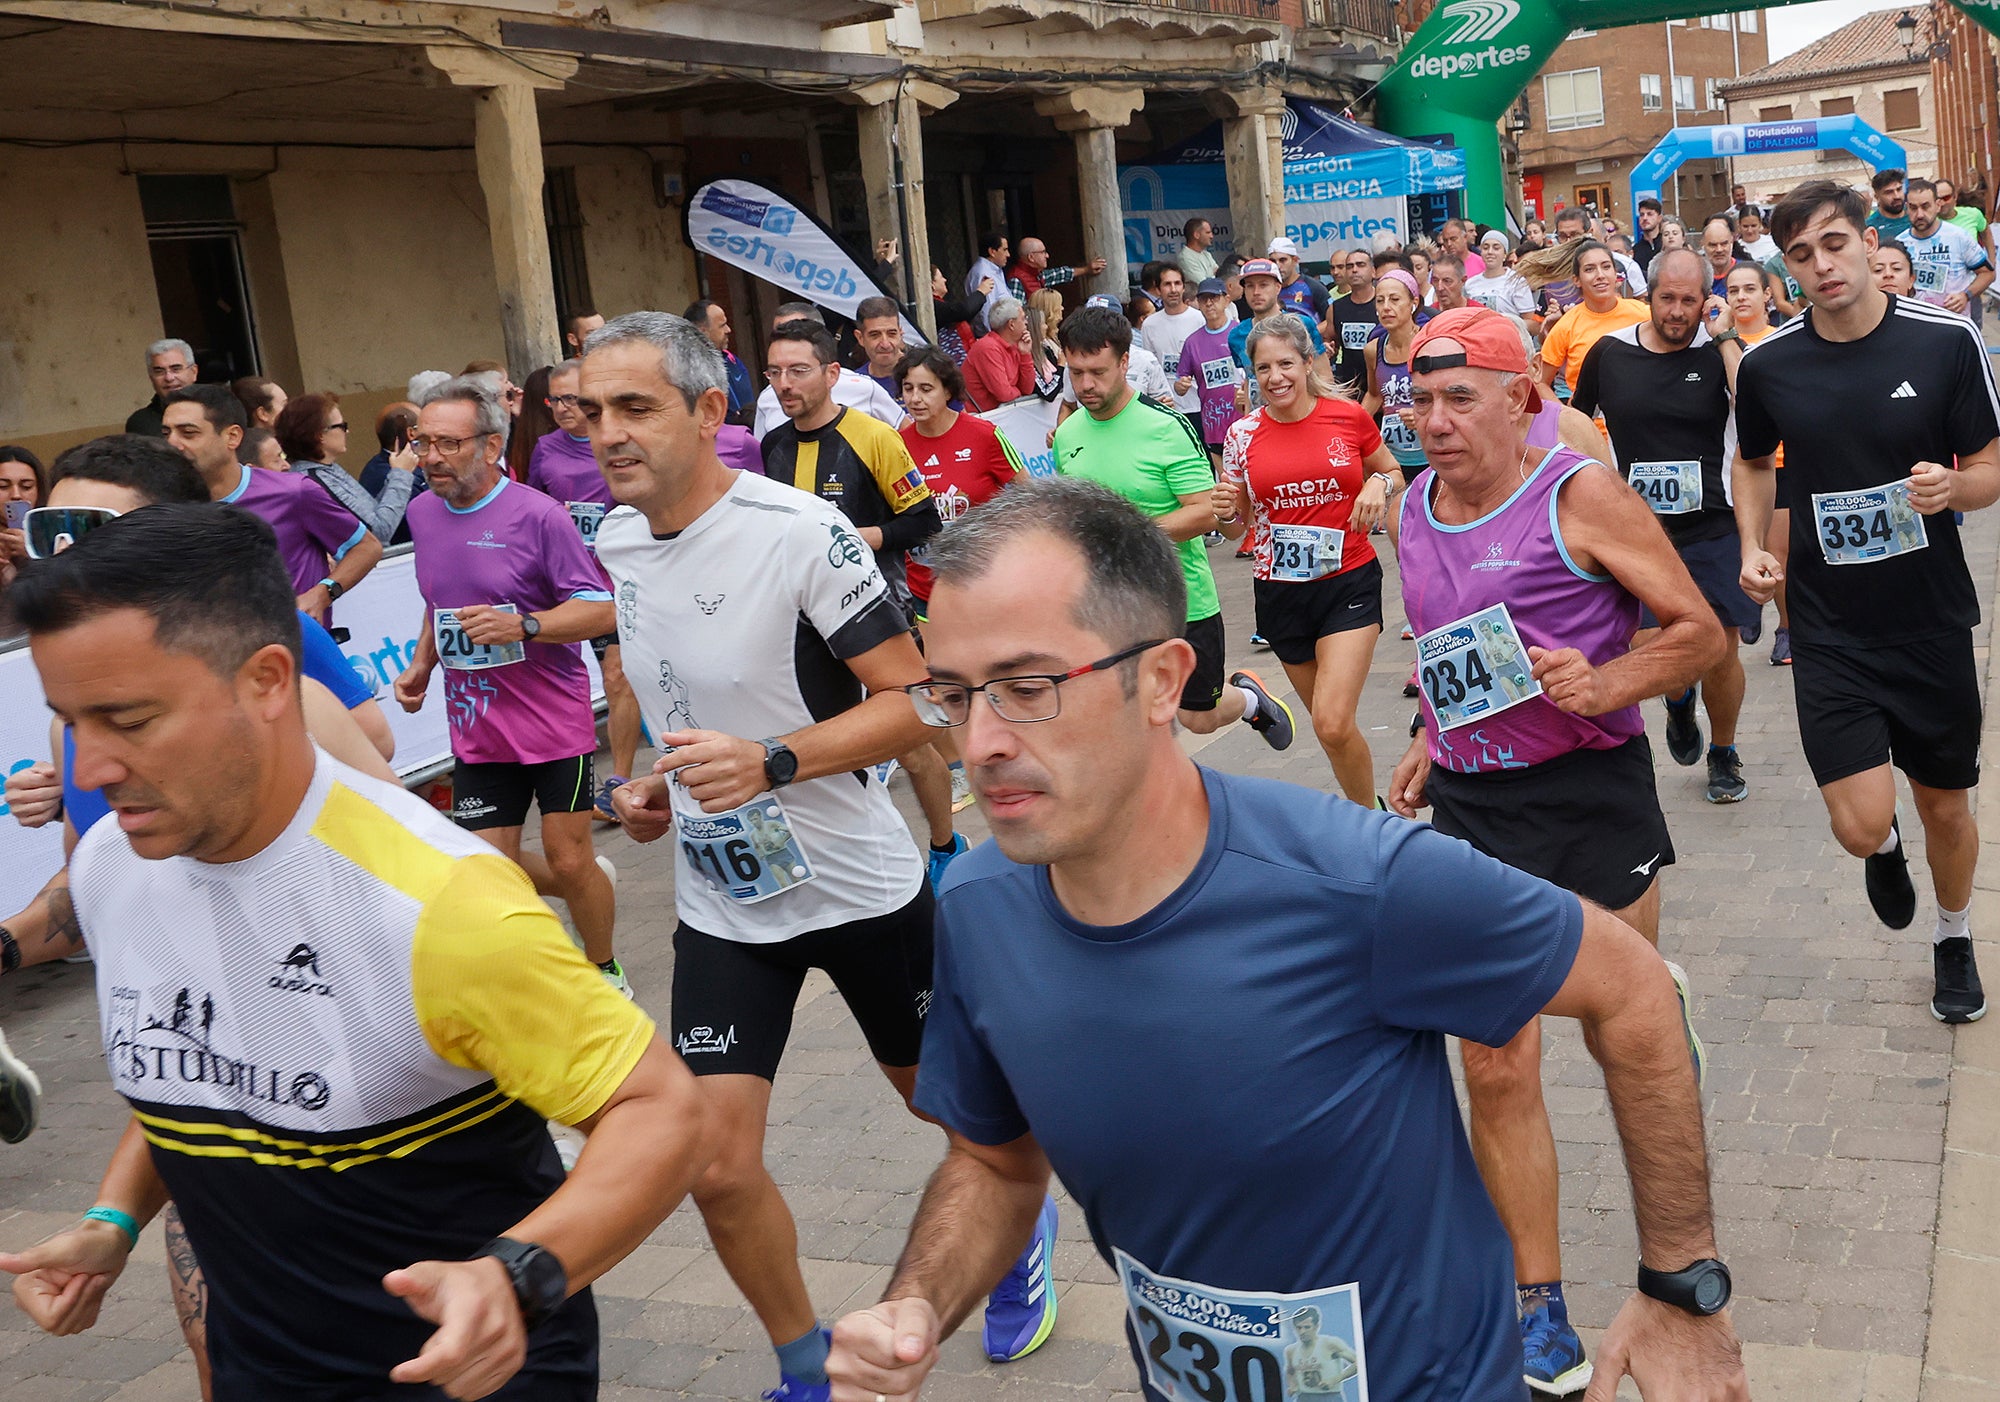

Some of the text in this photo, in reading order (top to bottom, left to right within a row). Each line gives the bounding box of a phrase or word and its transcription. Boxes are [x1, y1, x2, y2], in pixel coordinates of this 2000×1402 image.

[1410, 44, 1531, 79] deportes
[1747, 125, 1803, 139] Diputación
[1748, 136, 1816, 149] DE PALENCIA
[1344, 331, 1366, 343] 332
[1206, 366, 1230, 383] 246
[1273, 478, 1340, 498] TROTA
[1632, 478, 1680, 502] 240
[1835, 496, 1867, 505] 10.000
[1822, 509, 1893, 549] 334
[1274, 542, 1315, 569] 231
[1423, 648, 1493, 709] 234
[1137, 1306, 1284, 1402] 230
